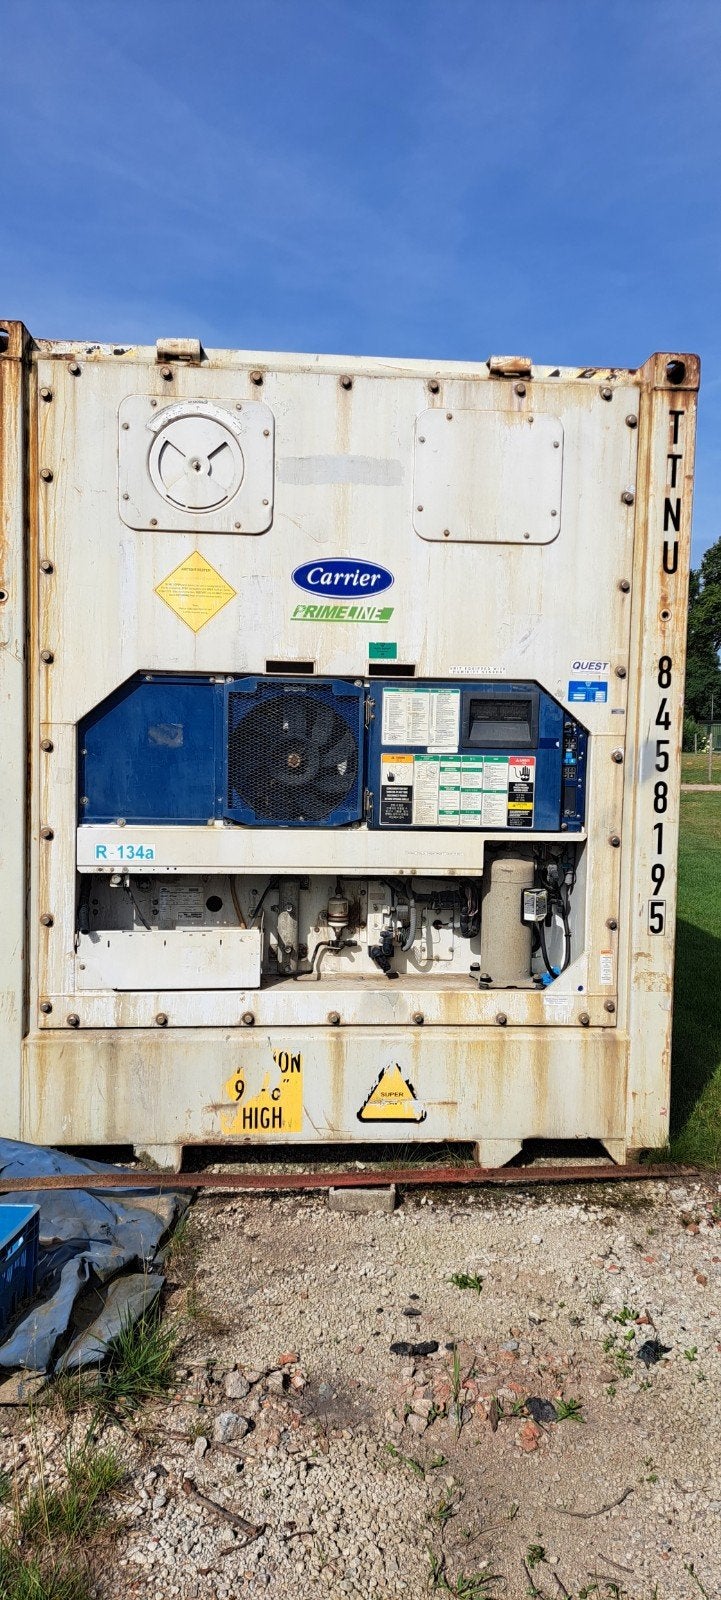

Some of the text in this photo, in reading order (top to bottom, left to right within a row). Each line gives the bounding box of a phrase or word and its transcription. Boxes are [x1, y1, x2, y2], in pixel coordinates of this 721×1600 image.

[663, 410, 685, 575] TTNU
[306, 566, 381, 588] Carrier
[292, 604, 384, 620] PRIMELINE
[572, 661, 610, 671] QUEST
[242, 1106, 282, 1130] HIGH
